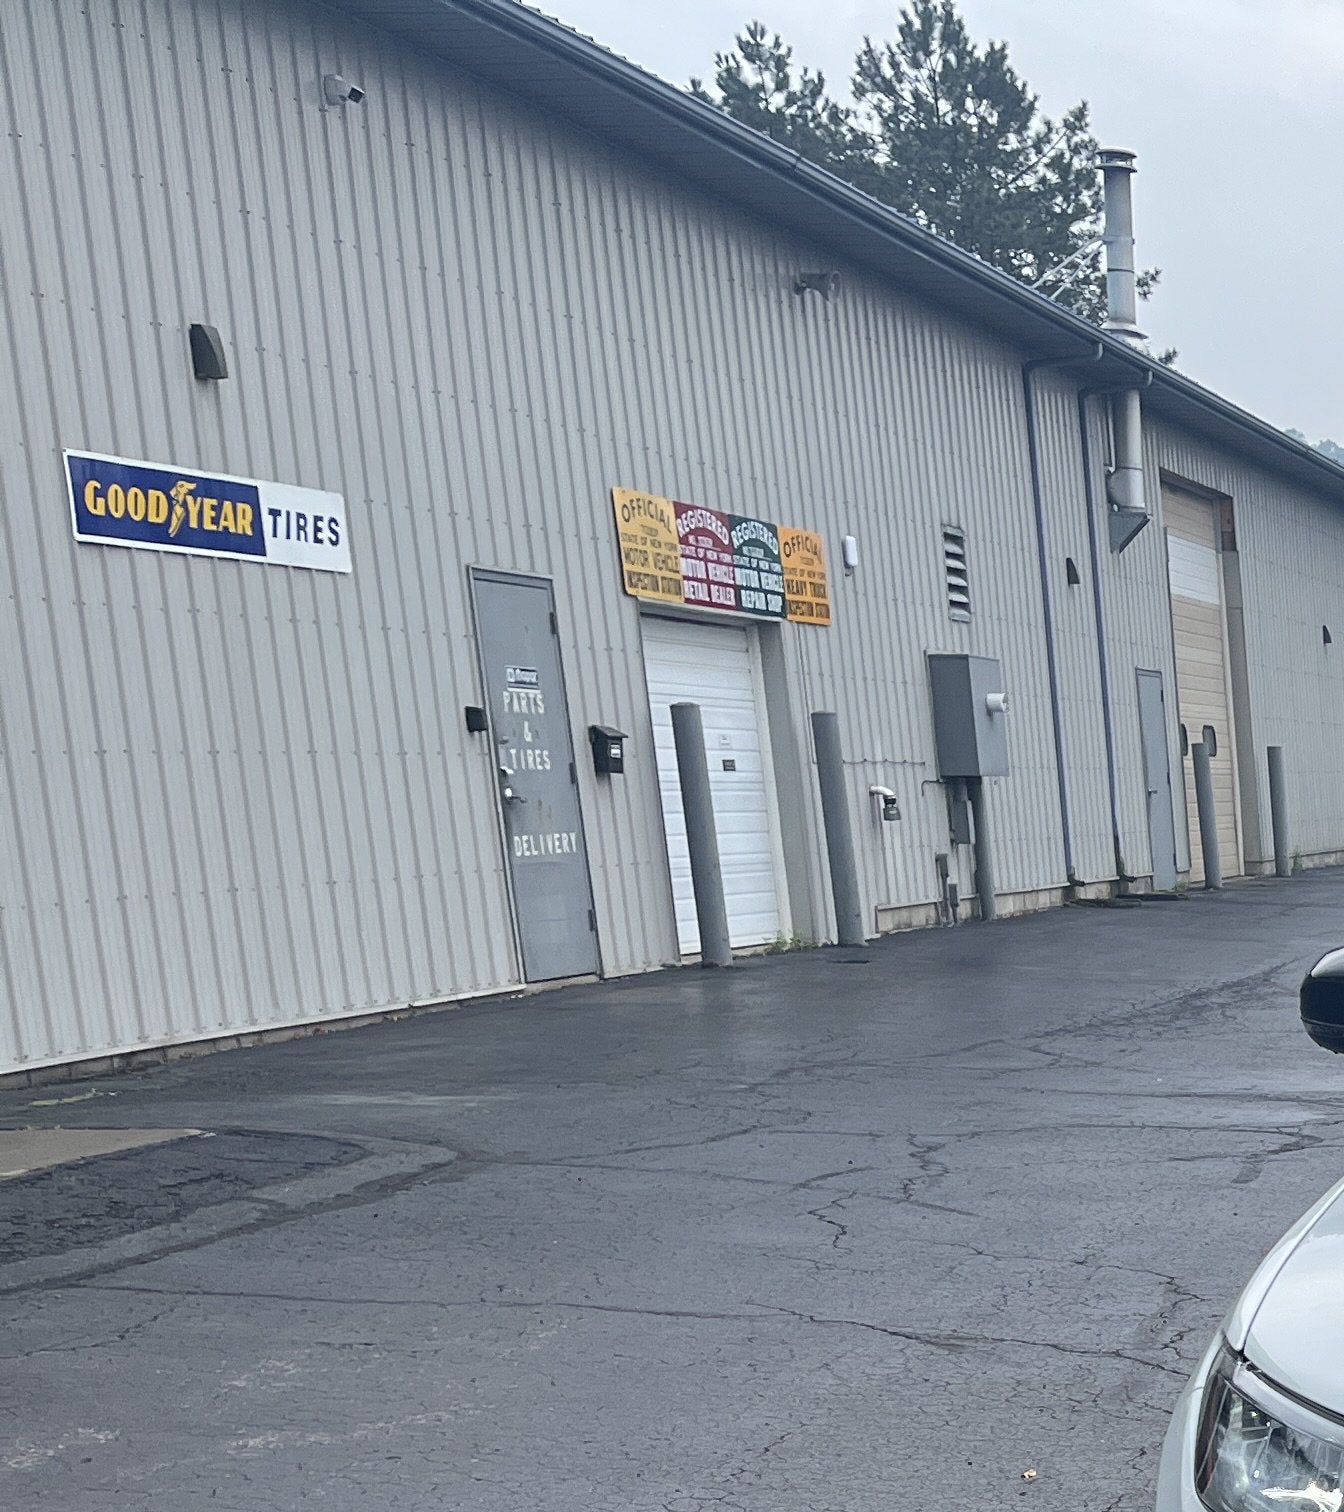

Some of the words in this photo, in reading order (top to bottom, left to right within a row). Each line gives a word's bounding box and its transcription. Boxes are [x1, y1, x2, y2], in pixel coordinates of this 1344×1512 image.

[267, 507, 341, 547] TIRES
[621, 498, 673, 535] OFFICIAL
[676, 508, 730, 546] REGISTERED
[730, 520, 779, 556] REGISTERED
[783, 534, 823, 565] OFFICIAL
[503, 691, 545, 715] PARTS
[510, 749, 551, 771] TIRES
[513, 831, 577, 857] DELIVERY
